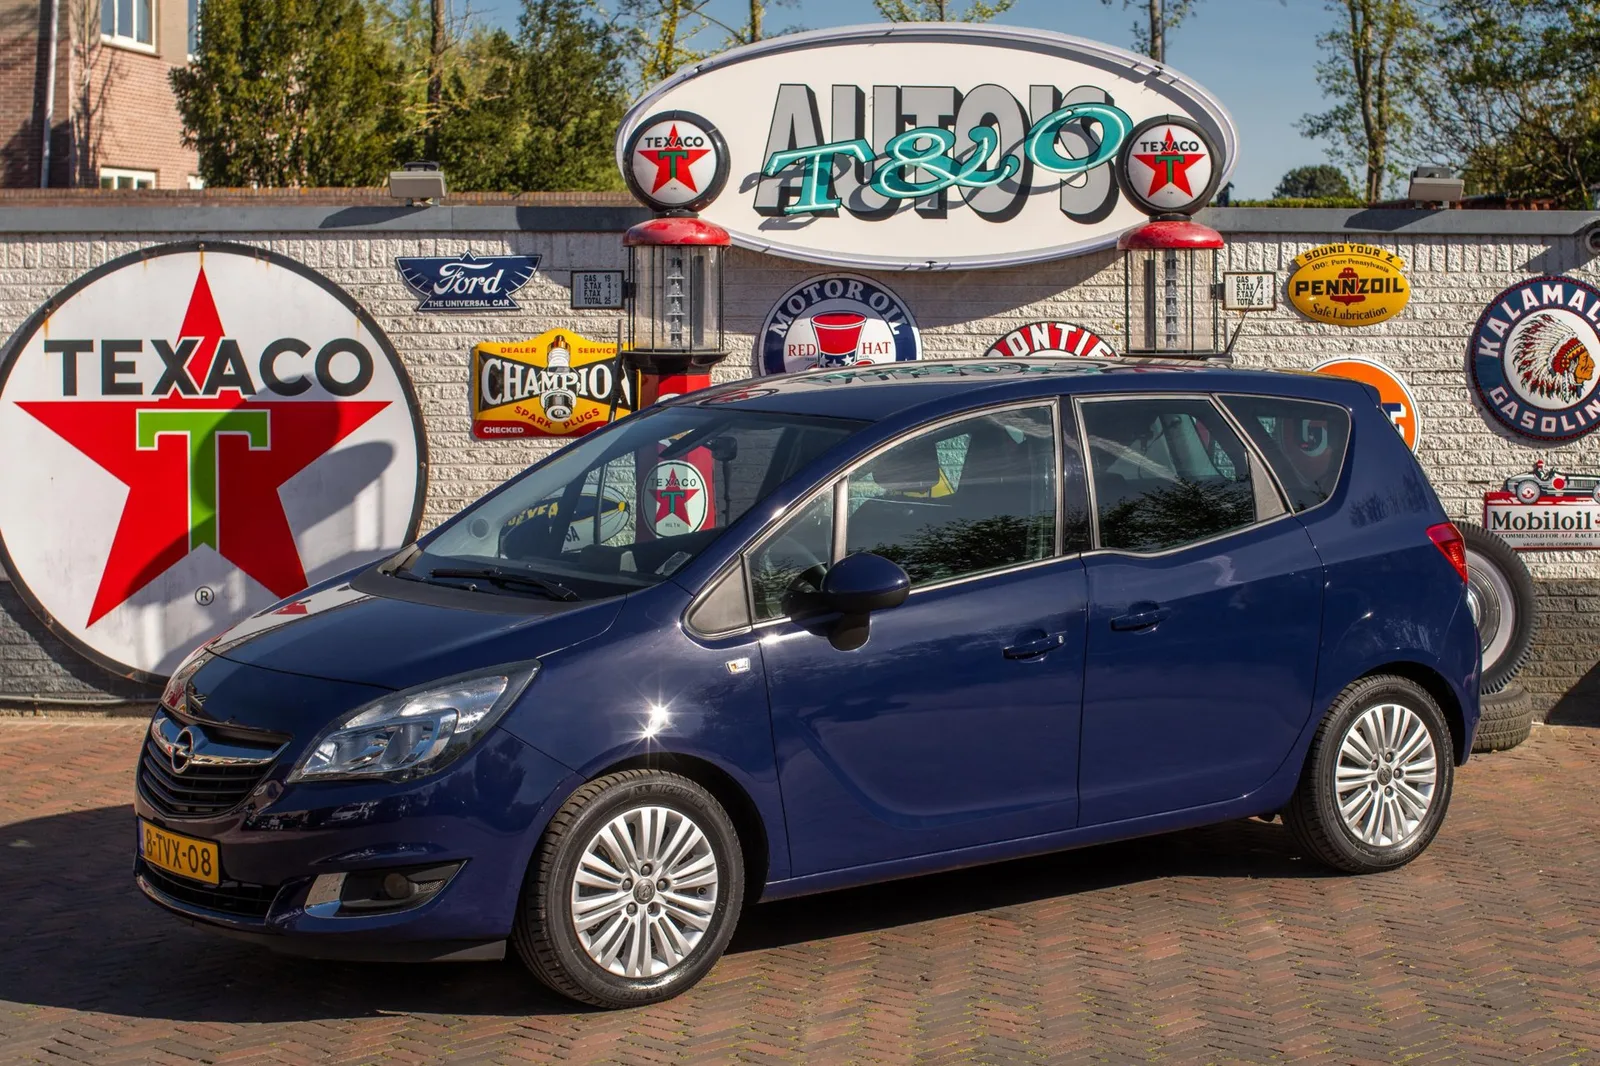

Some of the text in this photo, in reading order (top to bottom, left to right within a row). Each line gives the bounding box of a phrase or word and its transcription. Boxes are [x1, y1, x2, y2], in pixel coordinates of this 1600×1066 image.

[645, 136, 704, 148] TEXACO
[1140, 141, 1199, 152] TEXACO
[762, 102, 1134, 214] T&O
[1304, 244, 1395, 263] SOUND YOUR Z
[1348, 258, 1390, 273] Pennsylvania
[433, 262, 505, 295] Ford
[583, 274, 597, 282] GAS
[1236, 275, 1249, 283] GAS
[583, 282, 602, 290] S.TAX
[1236, 283, 1254, 291] S.TAX
[1295, 278, 1405, 297] PENNZOIL
[445, 299, 490, 307] UNIVERSAL
[492, 299, 510, 307] CAR
[584, 297, 612, 305] TOTAL 25
[769, 279, 908, 338] MOTOR OIL
[1236, 298, 1255, 306] TOTAL
[1310, 303, 1388, 320] Safe Lubrication
[788, 341, 891, 357] RED HAT
[44, 338, 374, 397] TEXACO
[514, 405, 600, 429] SPARK PLUGS
[483, 426, 525, 434] CHECKED
[650, 478, 697, 487] TEXACO
[1491, 511, 1592, 530] Mobiloil
[146, 829, 212, 877] 8-TVX-08
